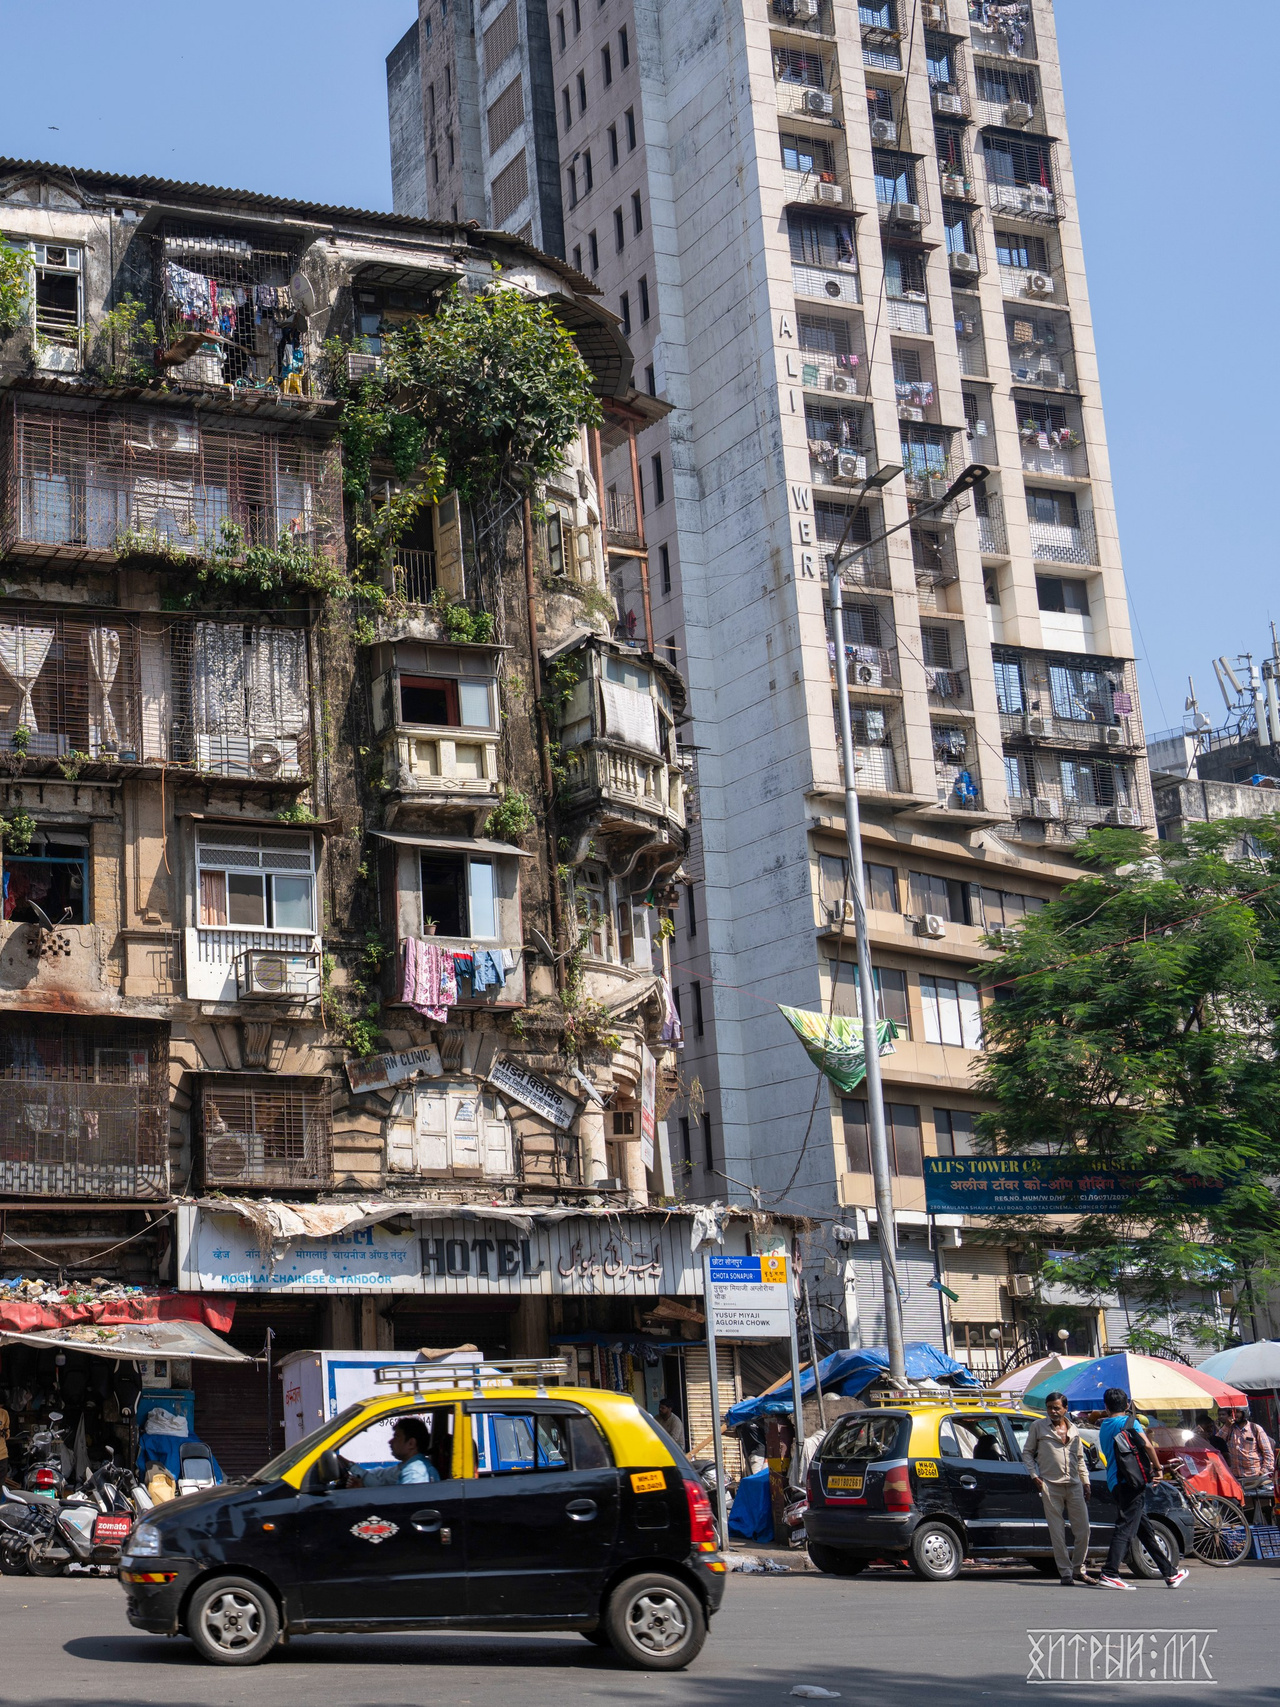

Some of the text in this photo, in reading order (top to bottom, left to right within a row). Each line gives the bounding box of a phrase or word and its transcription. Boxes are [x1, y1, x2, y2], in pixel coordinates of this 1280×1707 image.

[399, 1049, 431, 1066] CLINIC
[968, 1160, 1019, 1173] TOWER
[991, 1177, 1019, 1191] टॉवर
[419, 1238, 545, 1276] HOTEL
[221, 1275, 269, 1284] MOGHLAI
[329, 1275, 338, 1284] &
[340, 1275, 392, 1284] TANDOOR
[730, 1272, 754, 1280] SONAPUR
[97, 1522, 127, 1530] zomato
